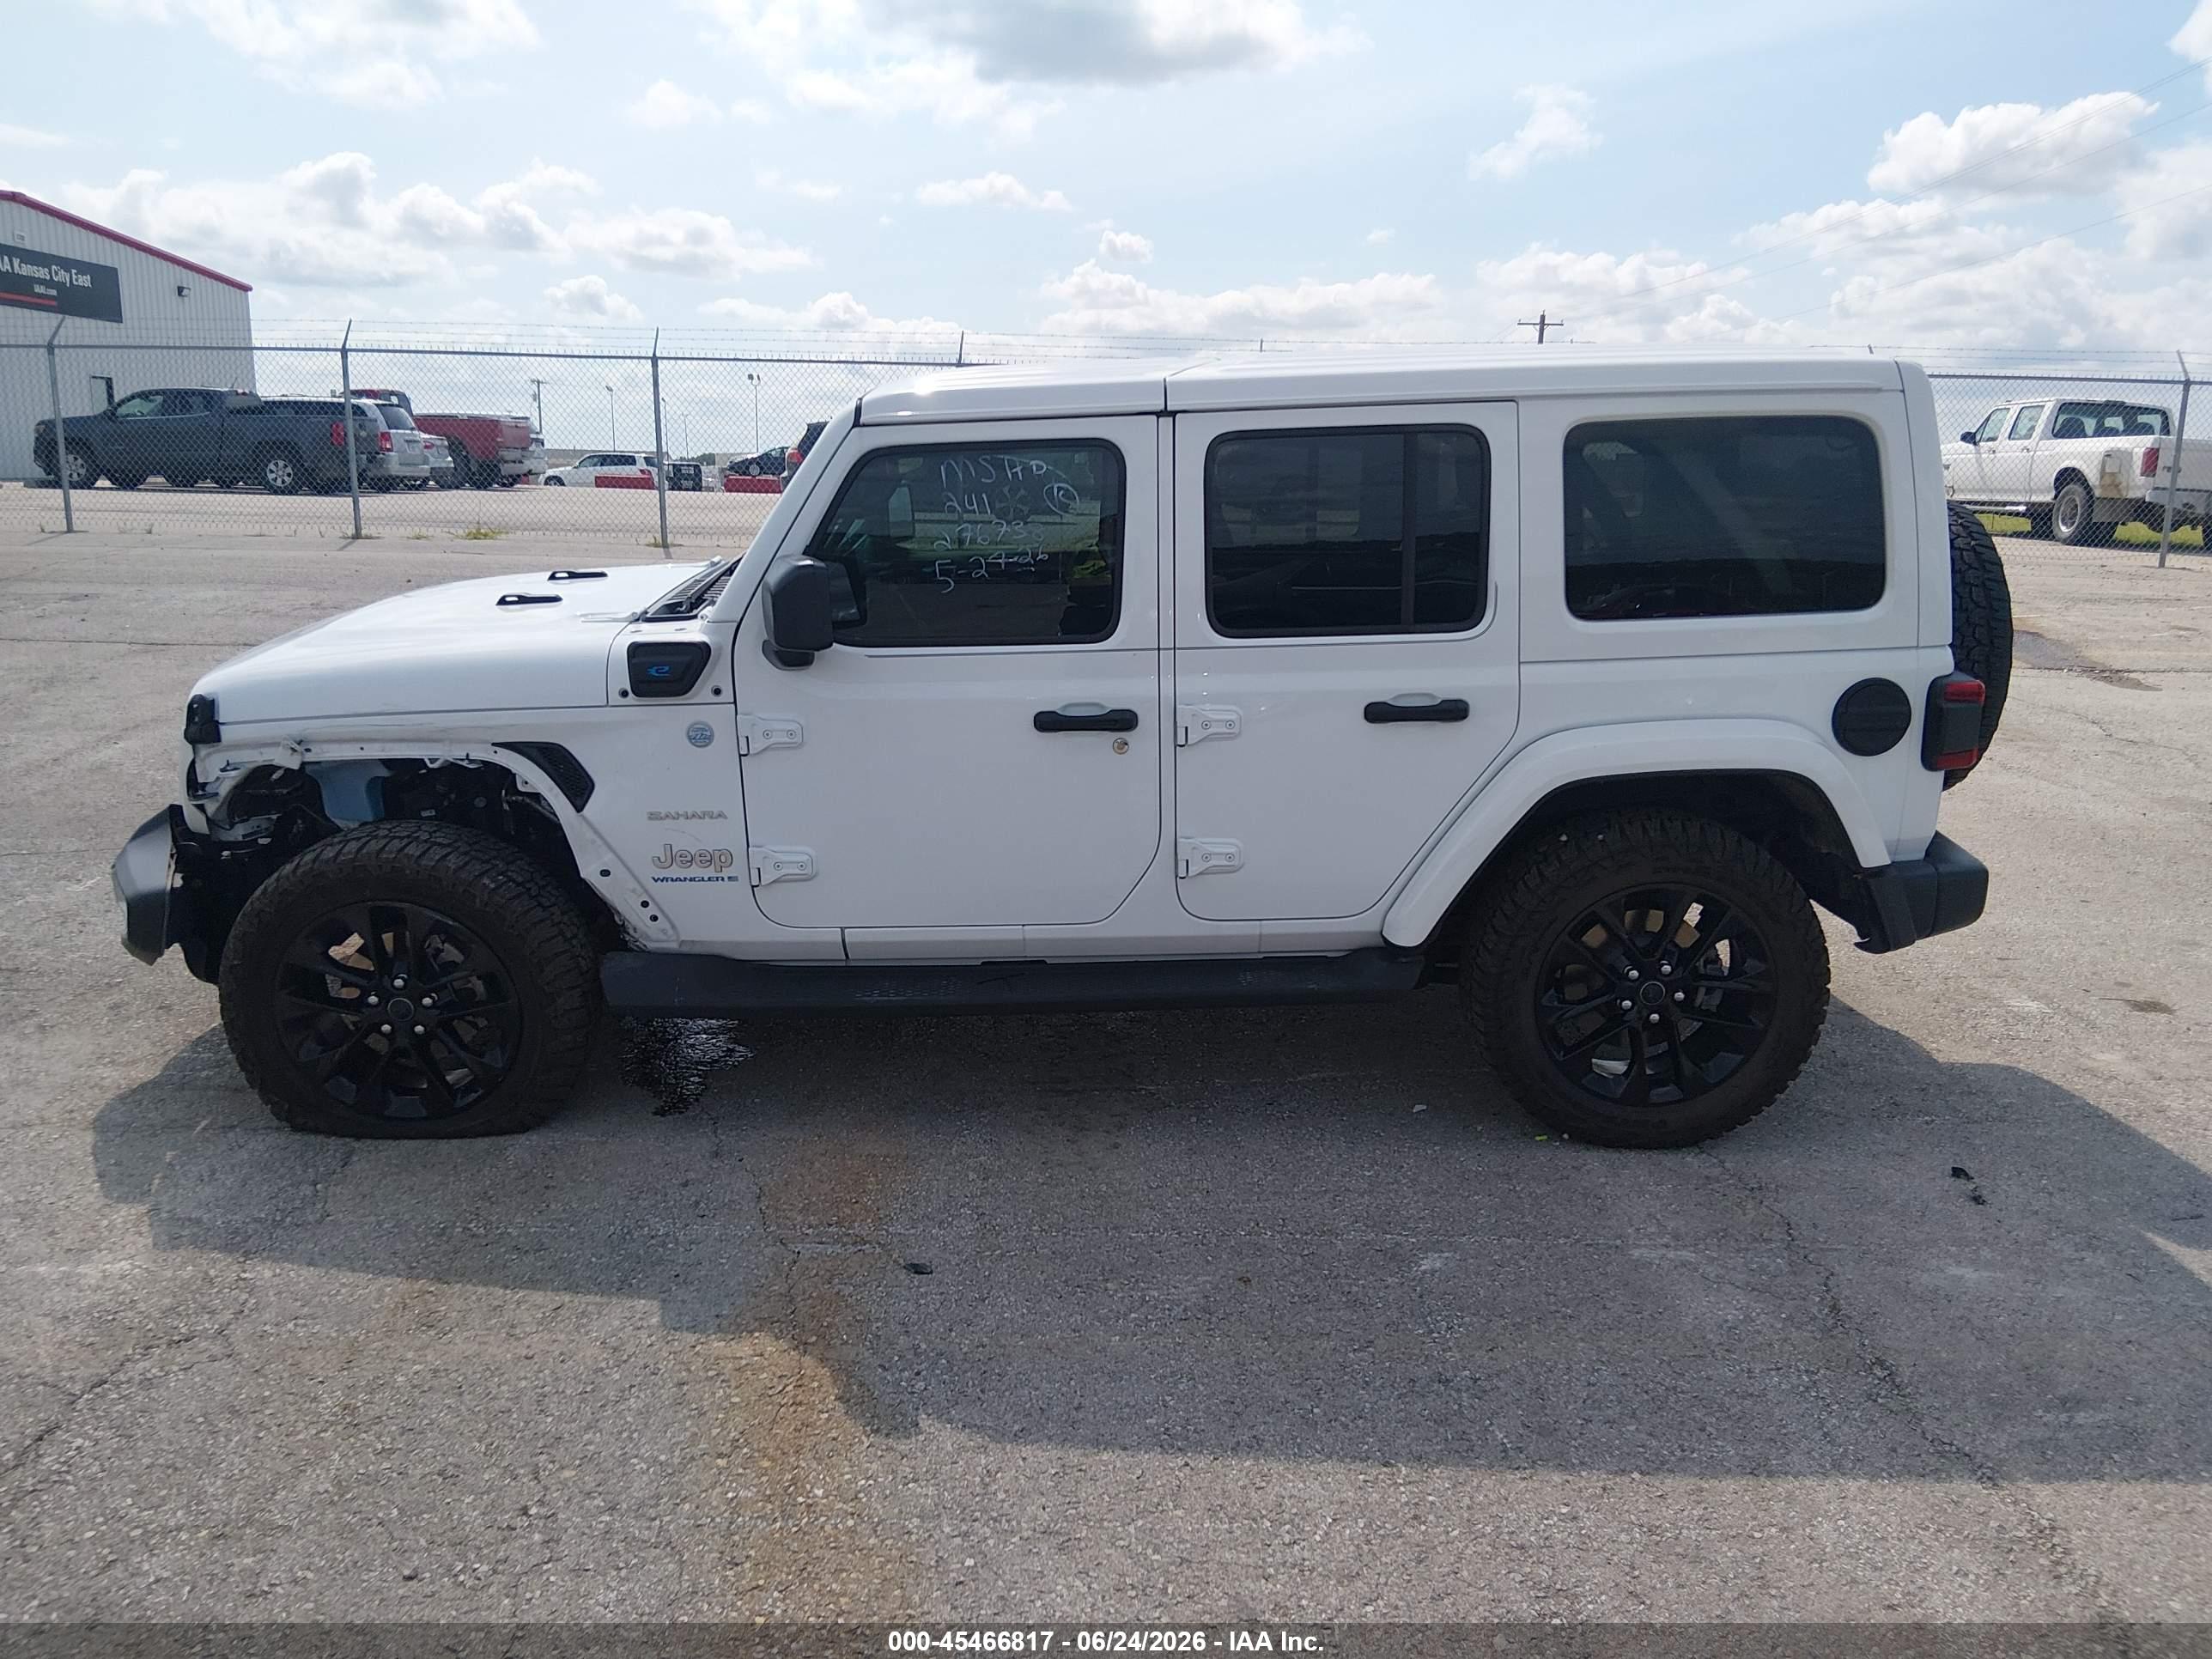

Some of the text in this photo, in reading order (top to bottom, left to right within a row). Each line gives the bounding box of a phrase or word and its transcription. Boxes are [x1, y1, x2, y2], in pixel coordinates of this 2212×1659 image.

[12, 257, 51, 281] Kansas
[52, 264, 70, 288] City
[71, 269, 92, 288] East
[943, 492, 991, 516] 241
[647, 810, 728, 821] SAHARA
[652, 843, 733, 873] Jeep
